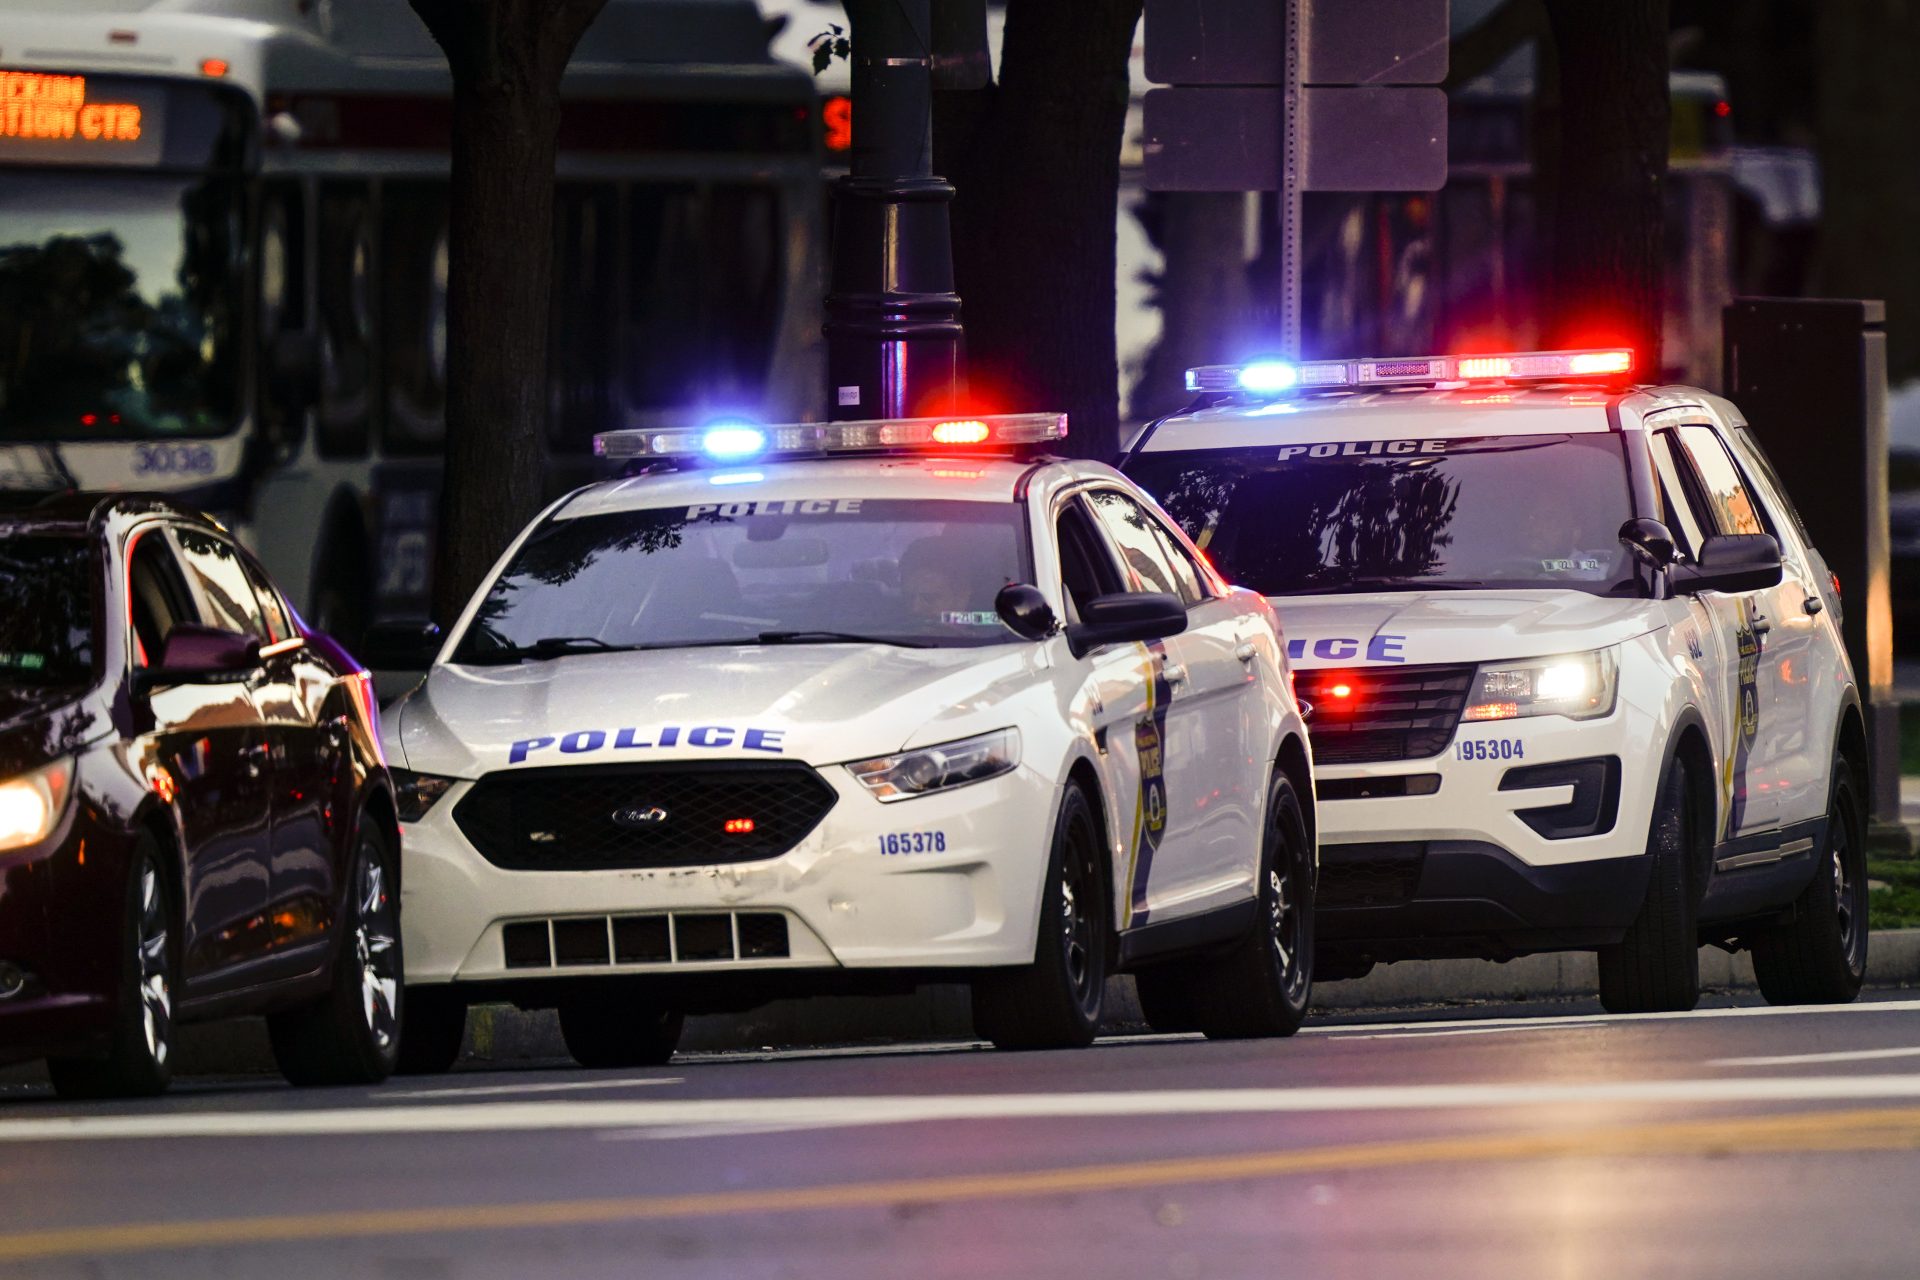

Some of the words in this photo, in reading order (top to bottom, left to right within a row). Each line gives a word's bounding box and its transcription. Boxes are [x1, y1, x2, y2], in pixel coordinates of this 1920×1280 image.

[80, 104, 141, 140] CTR
[1277, 440, 1447, 462] POLICE
[685, 499, 863, 520] POLICE
[1287, 635, 1406, 663] ICE
[508, 726, 786, 764] POLICE
[1454, 739, 1524, 761] 195304
[878, 831, 946, 855] 165378
